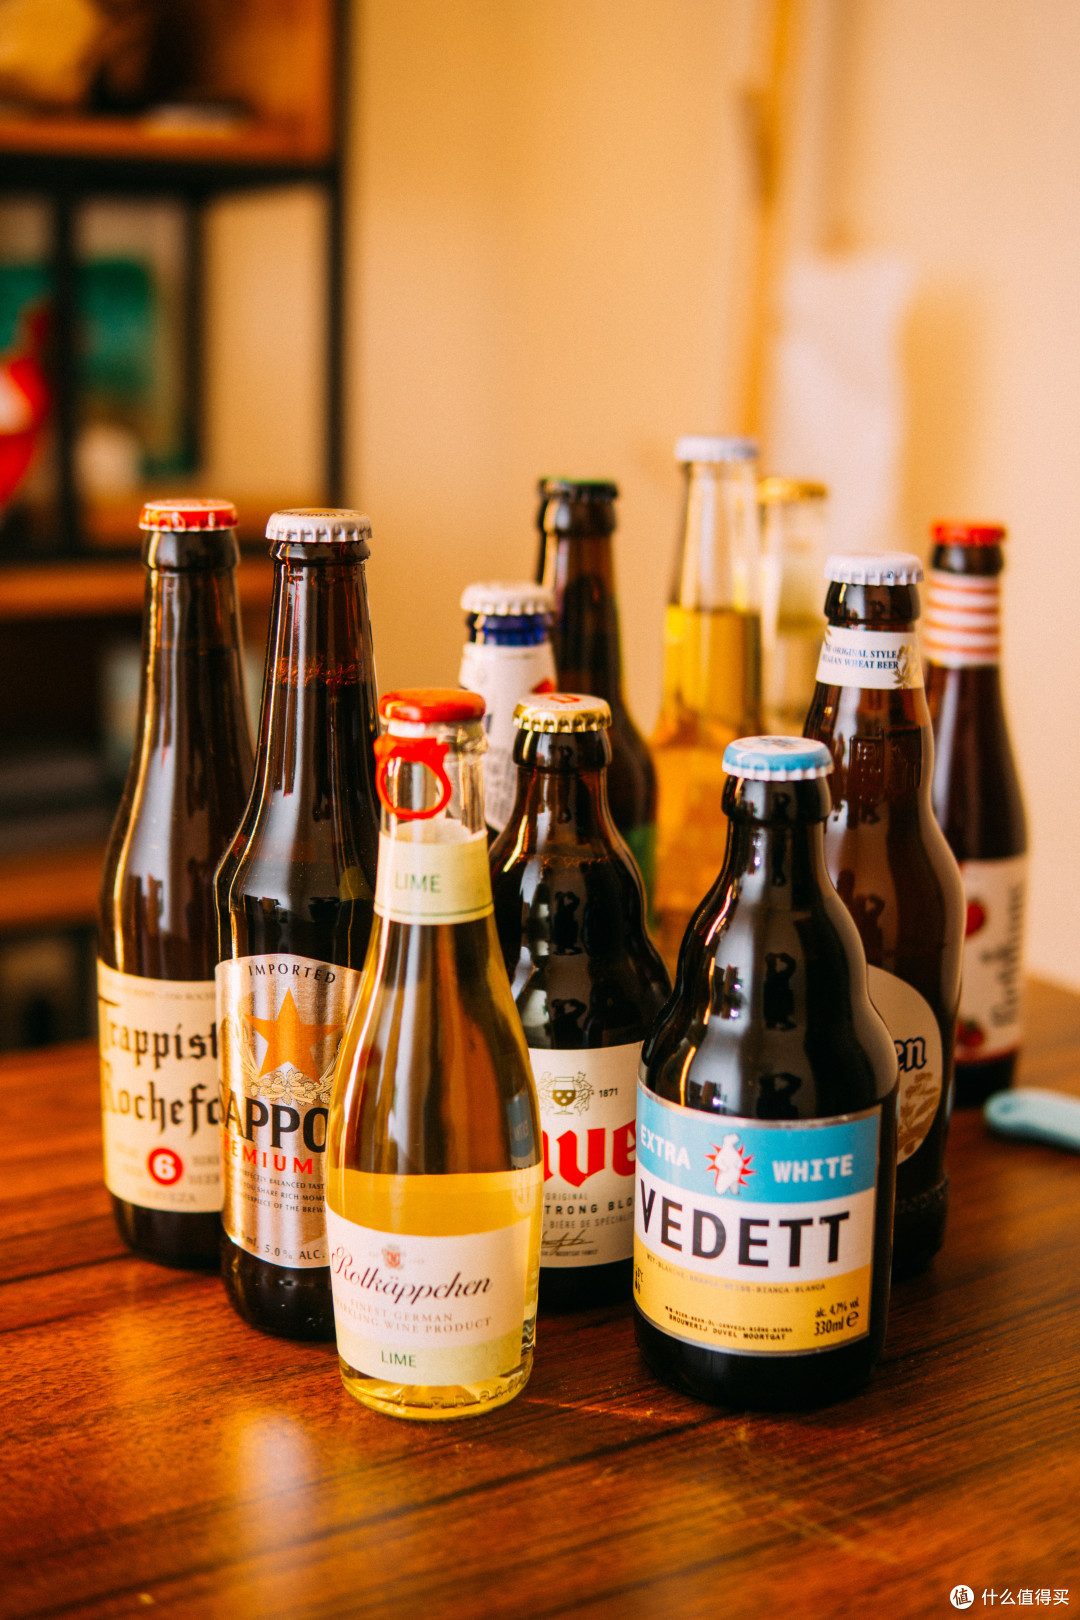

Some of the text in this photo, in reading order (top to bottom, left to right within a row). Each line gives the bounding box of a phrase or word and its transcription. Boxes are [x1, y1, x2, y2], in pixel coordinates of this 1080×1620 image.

[871, 649, 897, 658] STYLE
[844, 658, 874, 668] WHEAT
[877, 660, 899, 669] BEER
[394, 871, 441, 893] LIME
[248, 963, 336, 984] IMPORTED
[599, 1087, 618, 1098] 1871
[219, 1082, 329, 1153] APPO
[224, 1131, 313, 1175] EMIUM
[640, 1124, 853, 1183] EXTRA WHITE
[153, 1154, 176, 1180] 6
[269, 1178, 306, 1189] BALANCED
[281, 1192, 299, 1200] RICH
[545, 1192, 588, 1201] ORIGINAL
[285, 1204, 300, 1212] THE
[545, 1197, 633, 1215] TRONG BLO
[580, 1219, 590, 1229] DE
[640, 1178, 850, 1268] VEDETT
[299, 1249, 325, 1260] ALC.
[331, 1246, 493, 1305] Rotkäppchen
[384, 1319, 417, 1333] WINE
[426, 1316, 492, 1334] PRODUCT
[394, 1311, 453, 1323] GERMAN
[814, 1316, 844, 1336] 330ml
[713, 1327, 737, 1338] DUVEL
[381, 1350, 417, 1368] LIME
